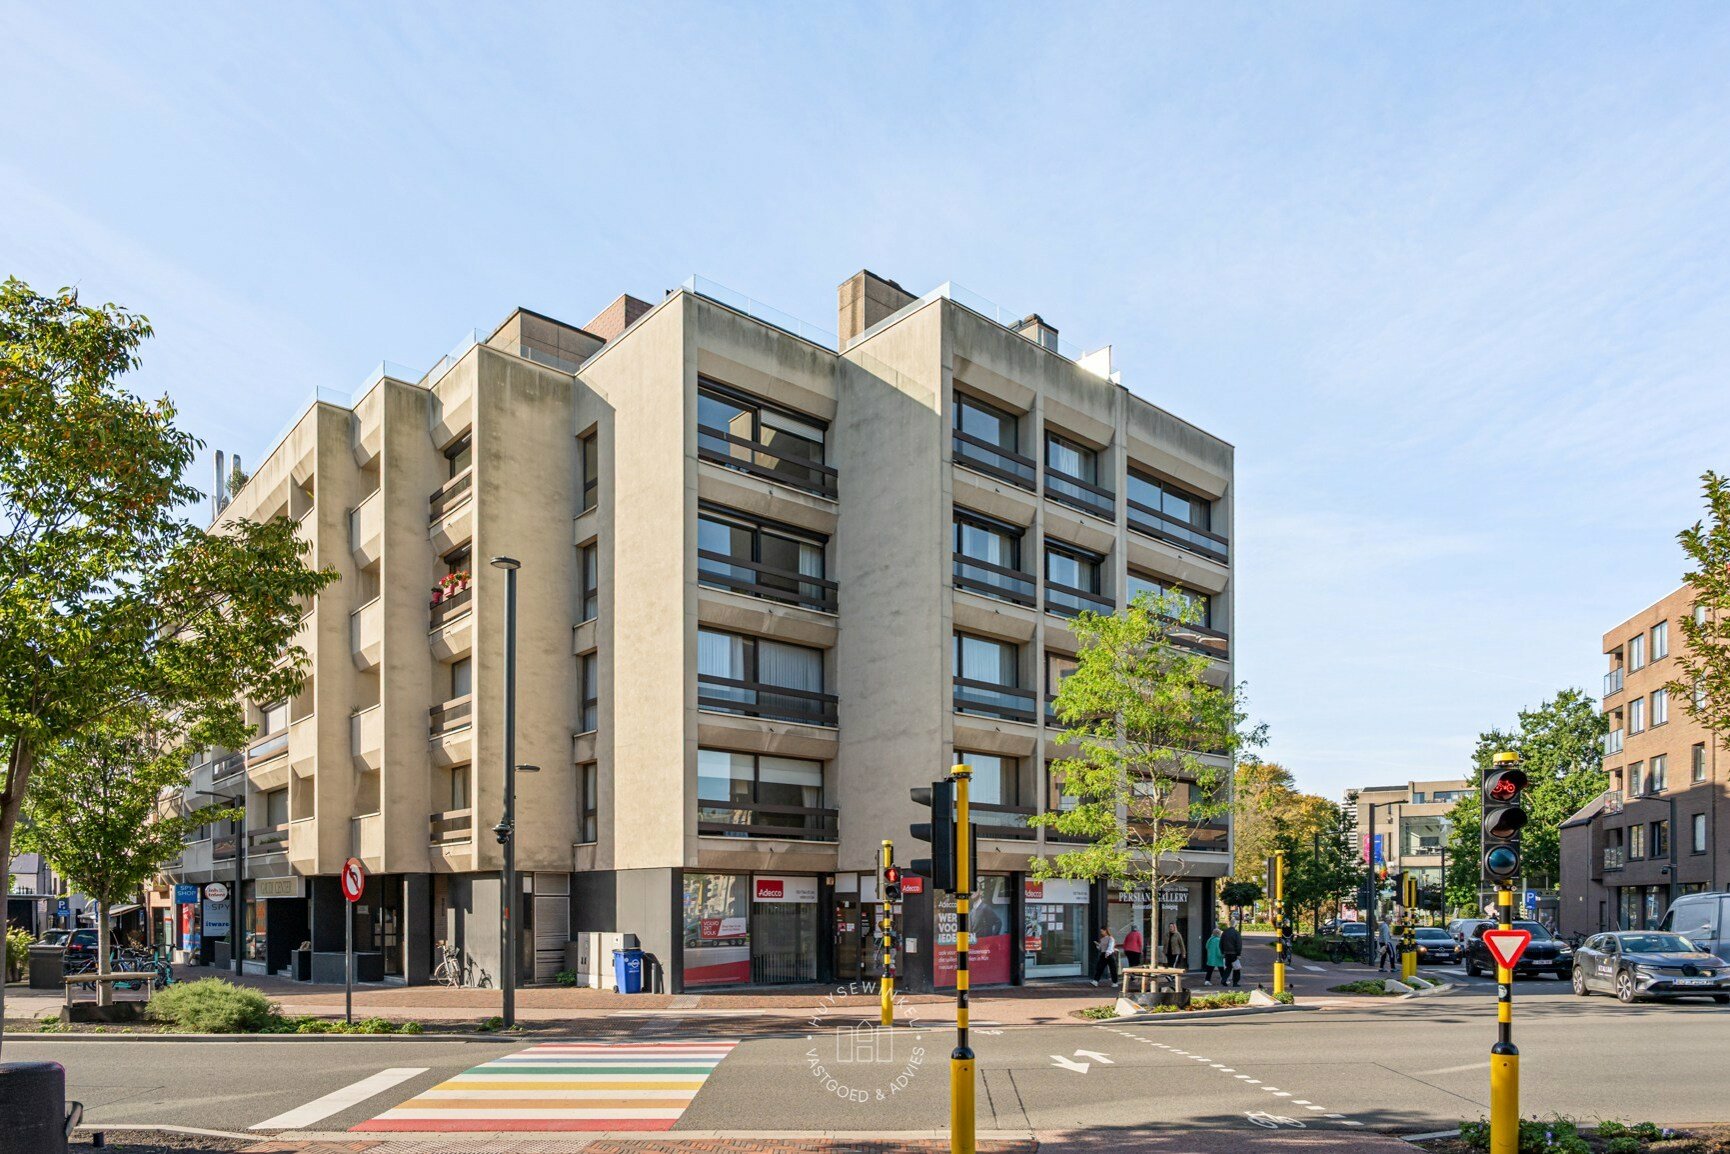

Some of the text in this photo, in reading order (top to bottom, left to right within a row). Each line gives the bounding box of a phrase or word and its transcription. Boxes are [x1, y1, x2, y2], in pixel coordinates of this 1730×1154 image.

[758, 888, 783, 897] Adecco
[1118, 892, 1151, 902] PERSIAN
[1526, 892, 1535, 903] P
[938, 912, 957, 923] WER
[938, 923, 957, 933] VOO
[938, 932, 977, 943] IEDEEN
